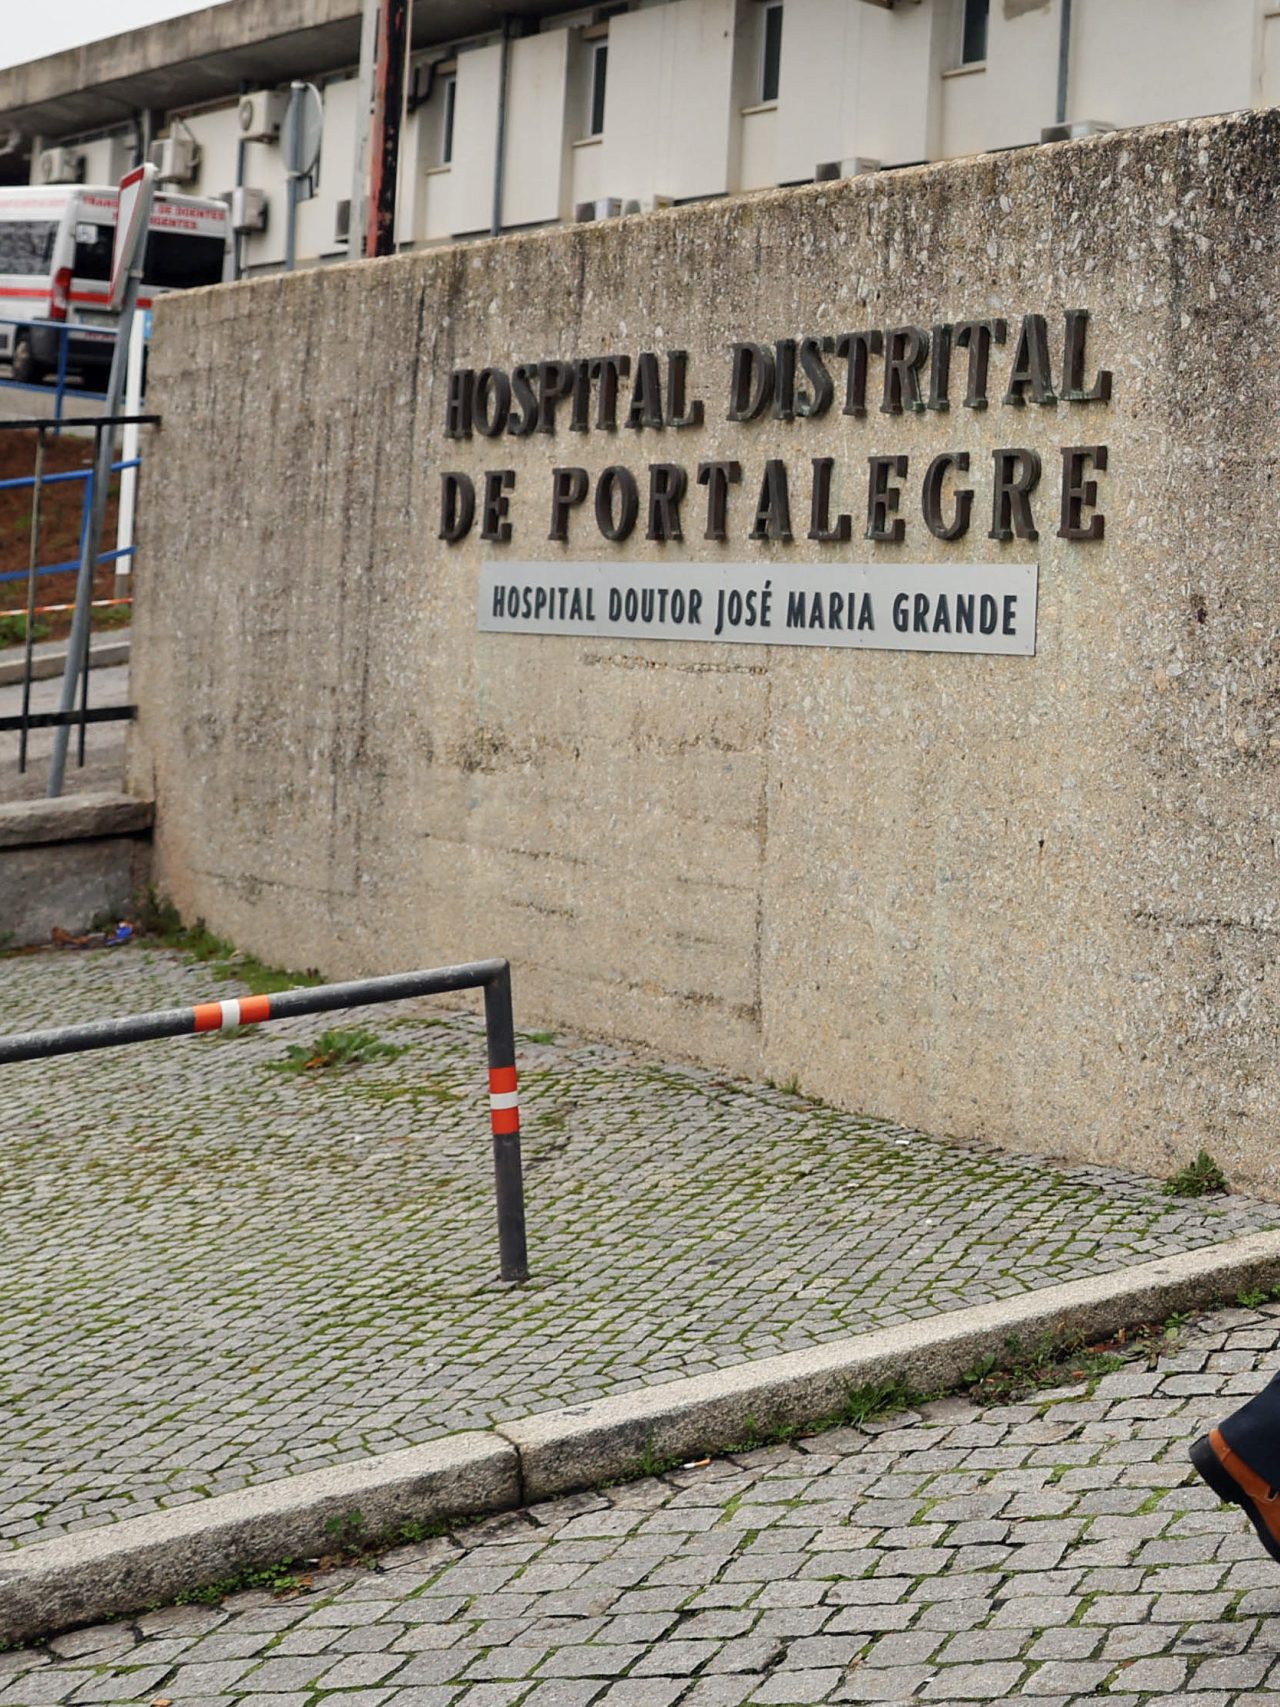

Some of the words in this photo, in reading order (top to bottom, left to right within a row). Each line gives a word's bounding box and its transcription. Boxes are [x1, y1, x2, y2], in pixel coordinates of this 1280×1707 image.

[444, 350, 705, 439] HOSPITAL
[726, 309, 1113, 422] DISTRITAL
[438, 470, 516, 543] DE
[548, 445, 1108, 542] PORTALEGRE
[492, 585, 596, 621] HOSPITAL
[608, 587, 703, 625] DOUTOR
[714, 580, 772, 635] JOSÉ
[786, 591, 875, 631] MARIA
[893, 592, 1018, 635] GRANDE
